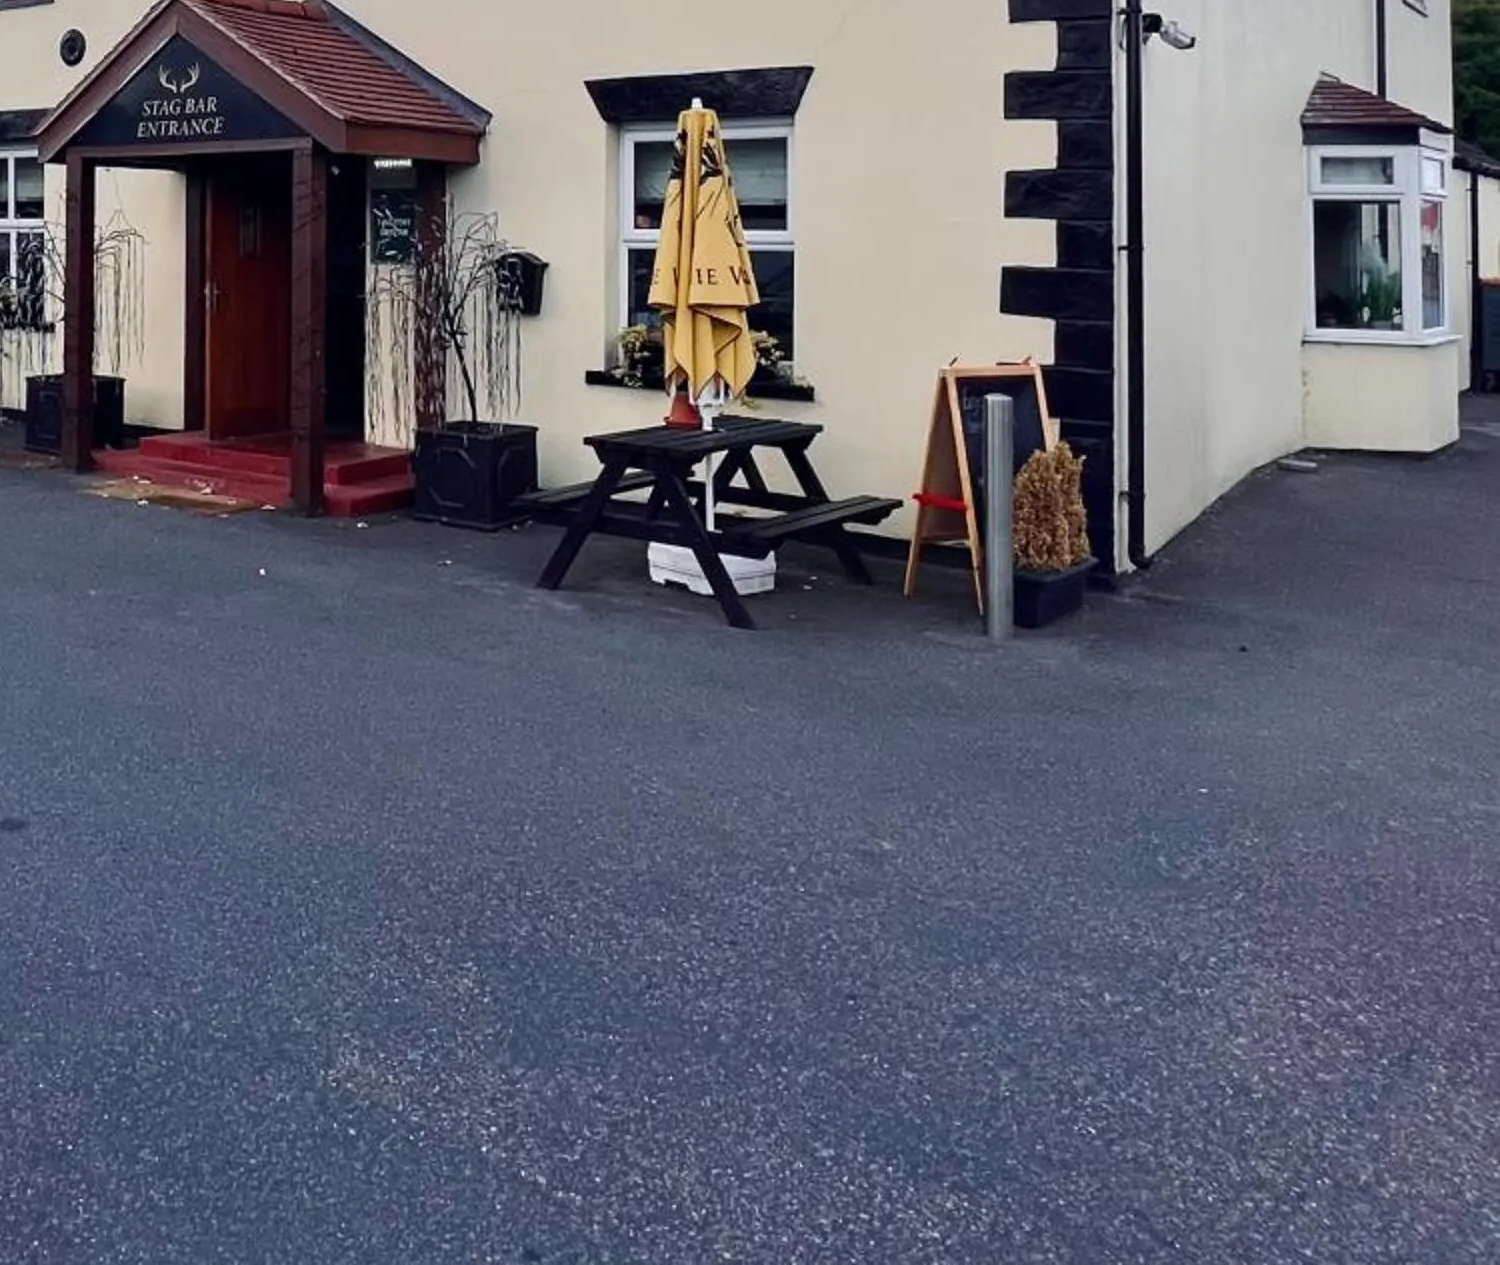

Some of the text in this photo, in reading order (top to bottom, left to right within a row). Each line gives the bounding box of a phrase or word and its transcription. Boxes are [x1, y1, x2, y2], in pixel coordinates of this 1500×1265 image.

[142, 96, 217, 117] STAG BAR
[137, 116, 225, 138] ENTRANCE
